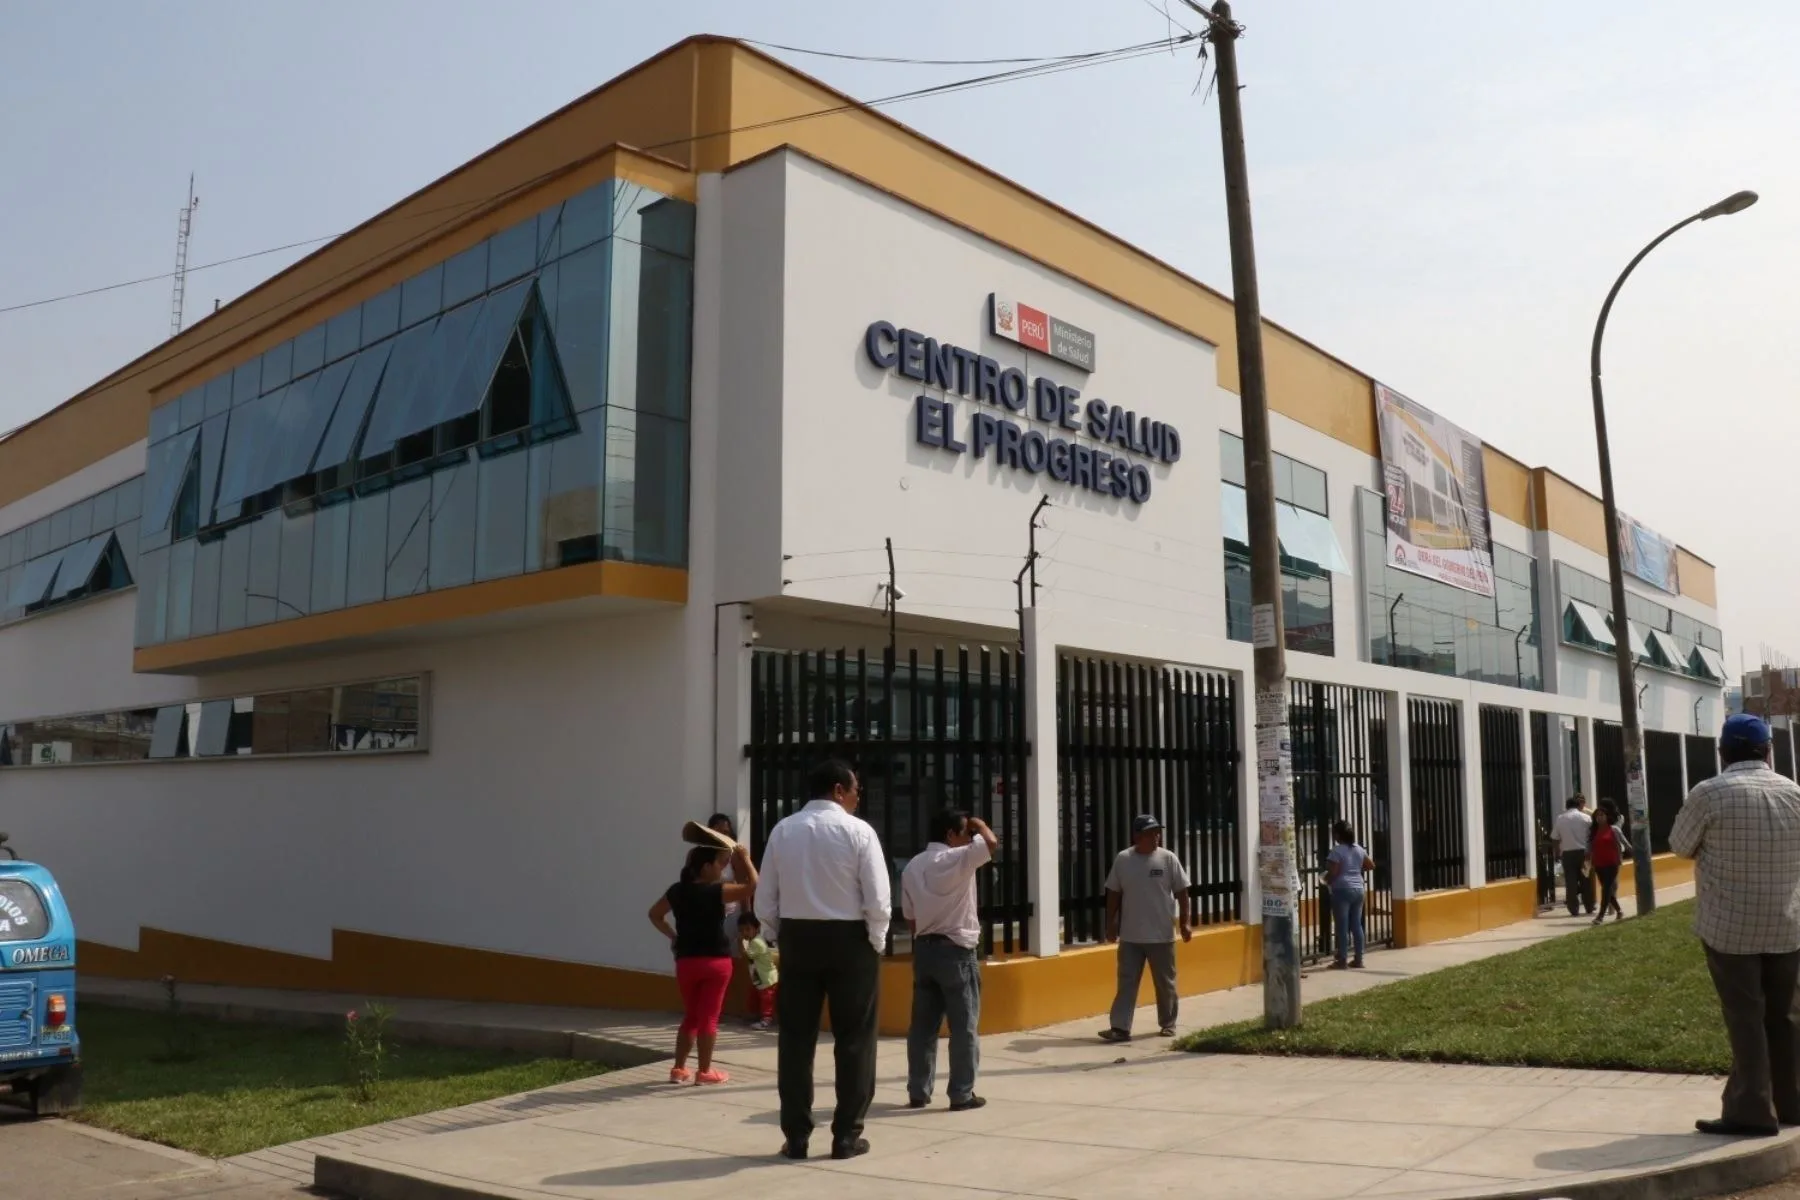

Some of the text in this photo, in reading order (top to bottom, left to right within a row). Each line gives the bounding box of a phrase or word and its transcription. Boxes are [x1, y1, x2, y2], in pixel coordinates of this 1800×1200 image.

[1021, 319, 1045, 341] PERÚ
[1053, 323, 1092, 349] Ministerio
[1057, 341, 1089, 364] de Salud
[865, 319, 1181, 464] CENTRO DE SALUD
[916, 395, 1152, 504] EL PROGRESO
[12, 945, 70, 965] OMEGA
